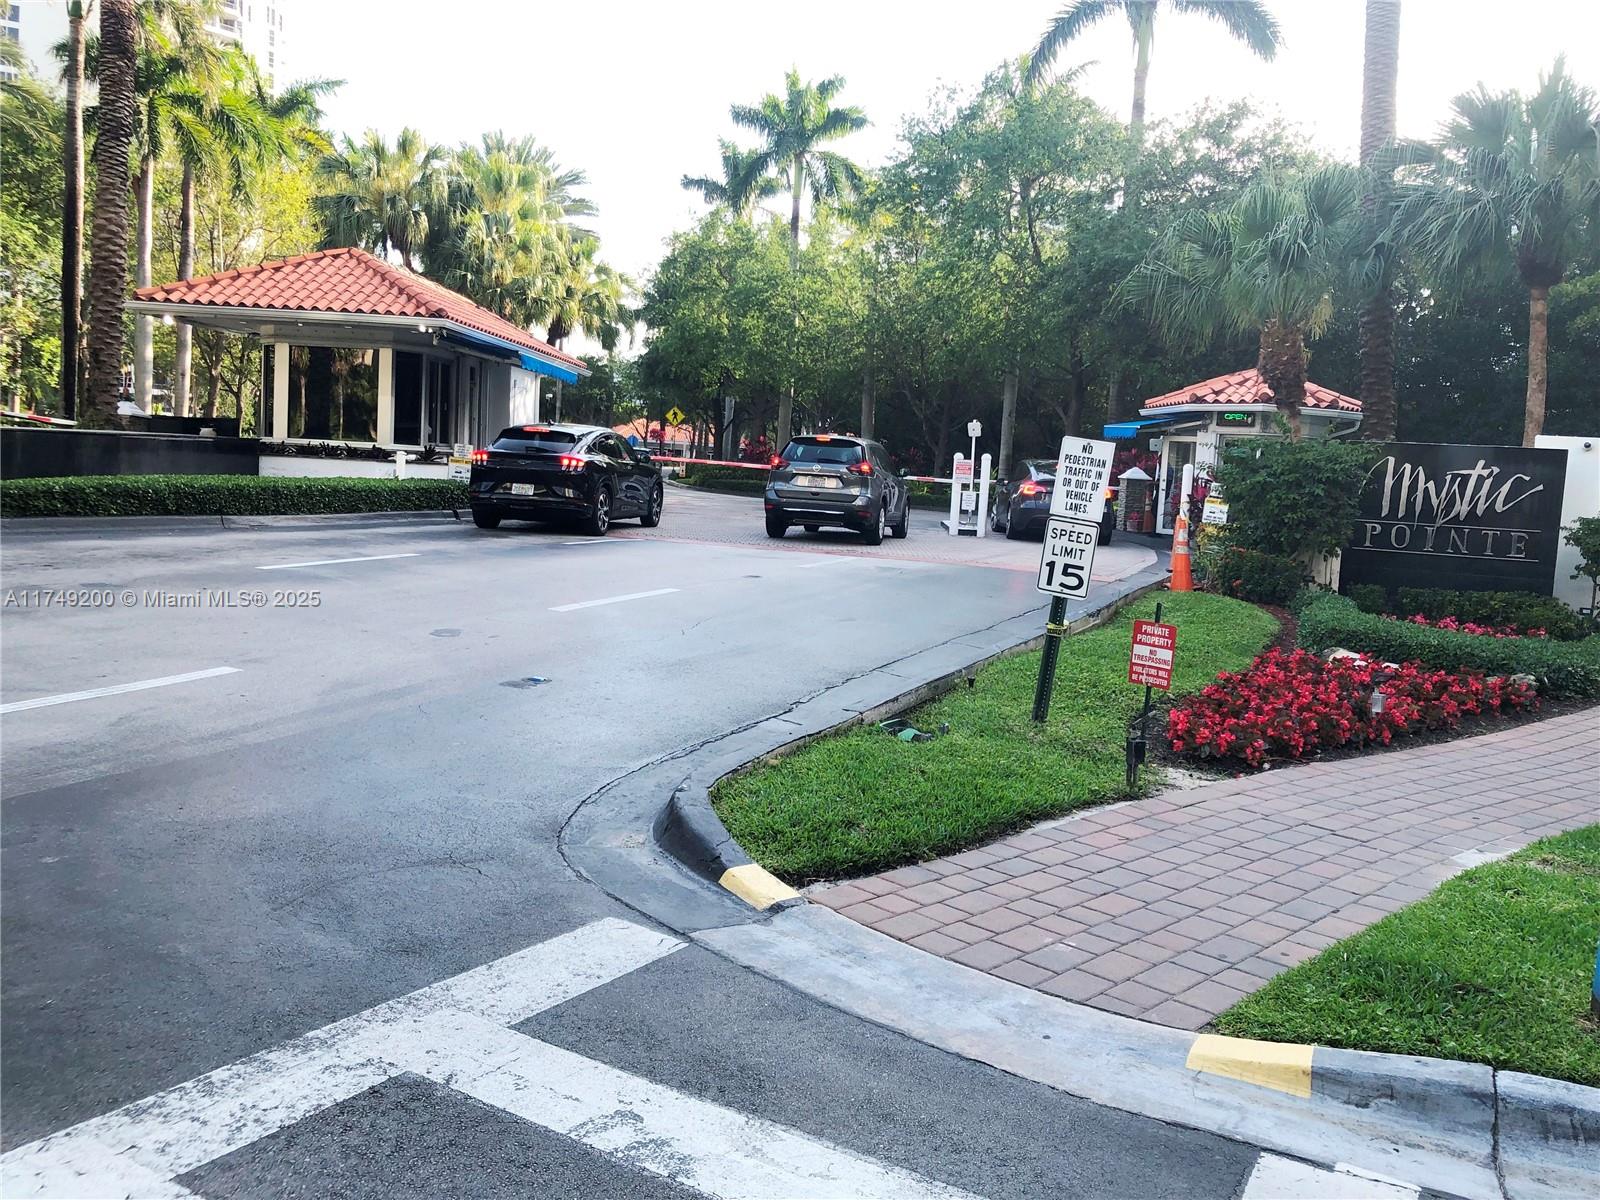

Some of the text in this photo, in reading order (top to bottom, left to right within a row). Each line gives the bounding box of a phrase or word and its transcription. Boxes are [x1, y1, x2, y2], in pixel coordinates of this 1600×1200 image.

[1082, 444, 1093, 454] NO
[1064, 454, 1106, 469] PEDESTRIAN
[1064, 465, 1103, 480] TRAFFIC IN
[1062, 477, 1100, 491] OR OUT OF
[1065, 489, 1093, 503] VEHICLE
[1358, 455, 1544, 530] Mystic
[1064, 501, 1089, 514] LANES.
[1050, 527, 1093, 545] SPEED
[1363, 522, 1530, 558] POINTE
[1051, 543, 1086, 561] LIMIT
[1045, 560, 1085, 591] 15
[1141, 624, 1170, 637] PRIVATE
[1136, 633, 1172, 648] PROPERTY
[1133, 653, 1171, 667] TRESPASSING
[1148, 648, 1158, 657] NO
